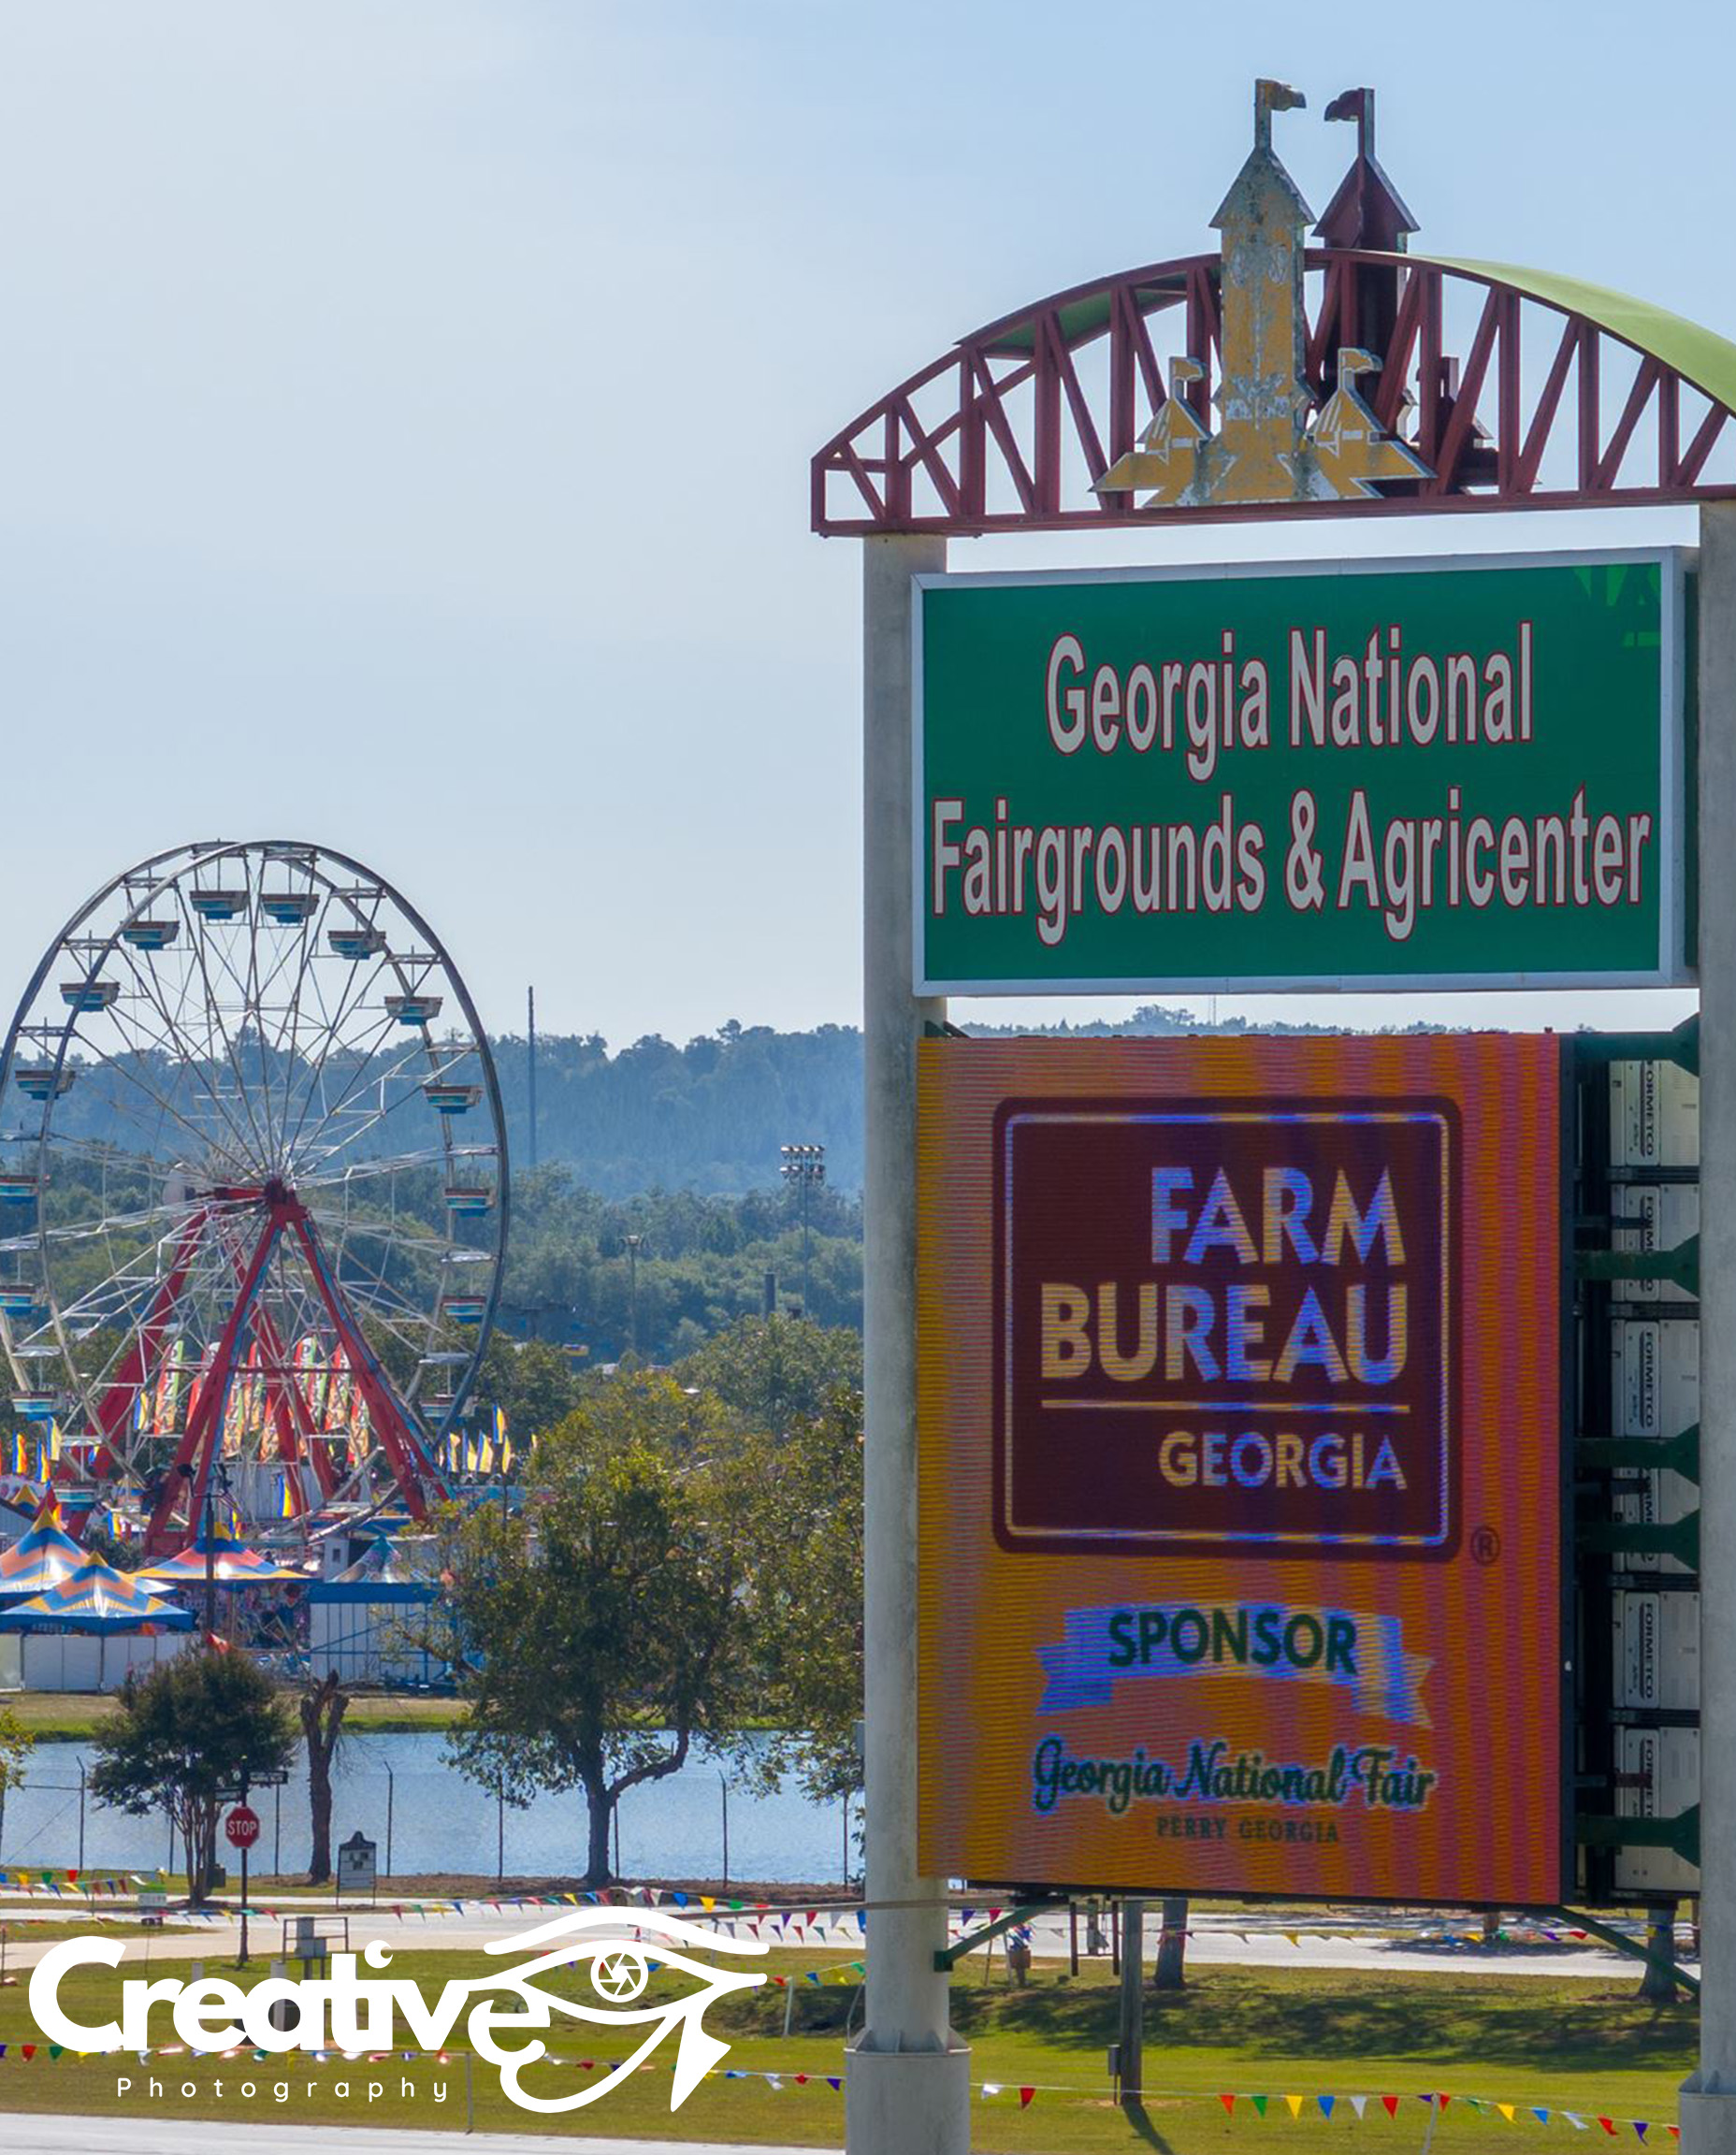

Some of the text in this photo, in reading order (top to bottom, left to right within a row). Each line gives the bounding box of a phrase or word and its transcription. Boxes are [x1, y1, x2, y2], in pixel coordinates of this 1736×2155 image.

[1045, 620, 1534, 783] Georgia National
[932, 782, 1652, 947] Fairgrounds & Agricenter
[1150, 1165, 1407, 1266] FARM
[1040, 1280, 1409, 1384] BUREAU
[1645, 1332, 1655, 1427] FORMETCO
[1158, 1430, 1408, 1491] GEORGIA
[1107, 1607, 1358, 1676] SPONSOR
[1645, 1602, 1655, 1699] FORMETCO
[1033, 1734, 1438, 1815] Georgia National Fair
[228, 1820, 257, 1836] STOP
[1156, 1815, 1338, 1845] PERRY GEORGIA
